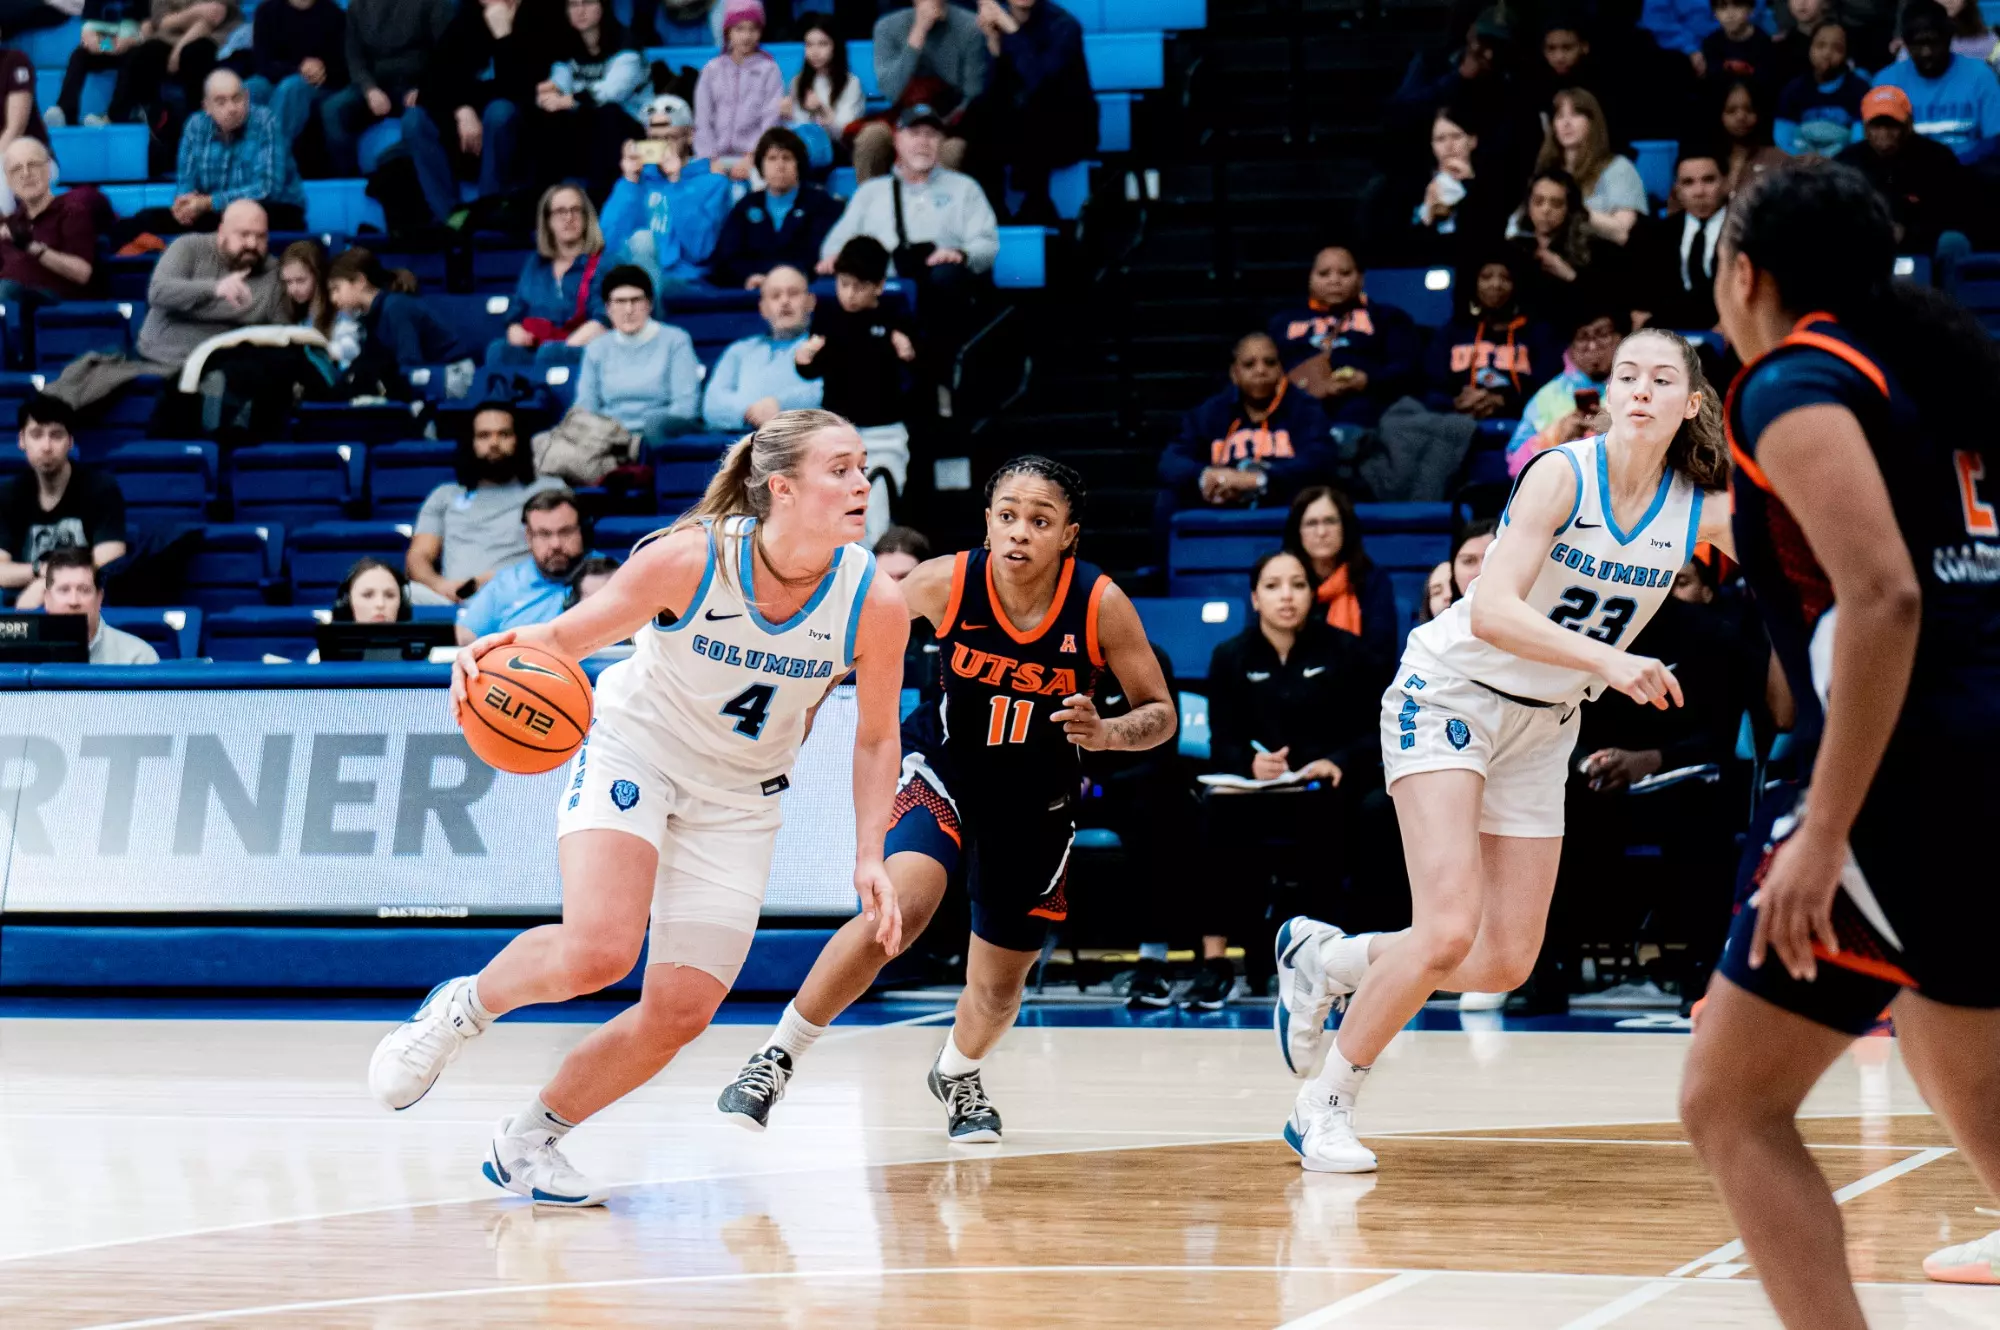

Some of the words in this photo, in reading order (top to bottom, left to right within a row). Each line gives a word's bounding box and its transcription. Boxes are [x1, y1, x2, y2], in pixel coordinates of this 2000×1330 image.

[1450, 342, 1532, 375] UTSA
[1550, 542, 1673, 588] COLUMBIA
[1650, 538, 1664, 549] Ivy
[808, 629, 825, 641] Ivy
[1547, 585, 1638, 647] 23
[692, 634, 833, 678] COLUMBIA
[1060, 634, 1077, 653] A
[951, 641, 1077, 696] UTSA
[484, 685, 556, 736] ELITE
[718, 681, 779, 741] 4
[986, 695, 1035, 746] 11
[0, 733, 498, 858] RTNER
[379, 906, 468, 918] DAKTRONICS
